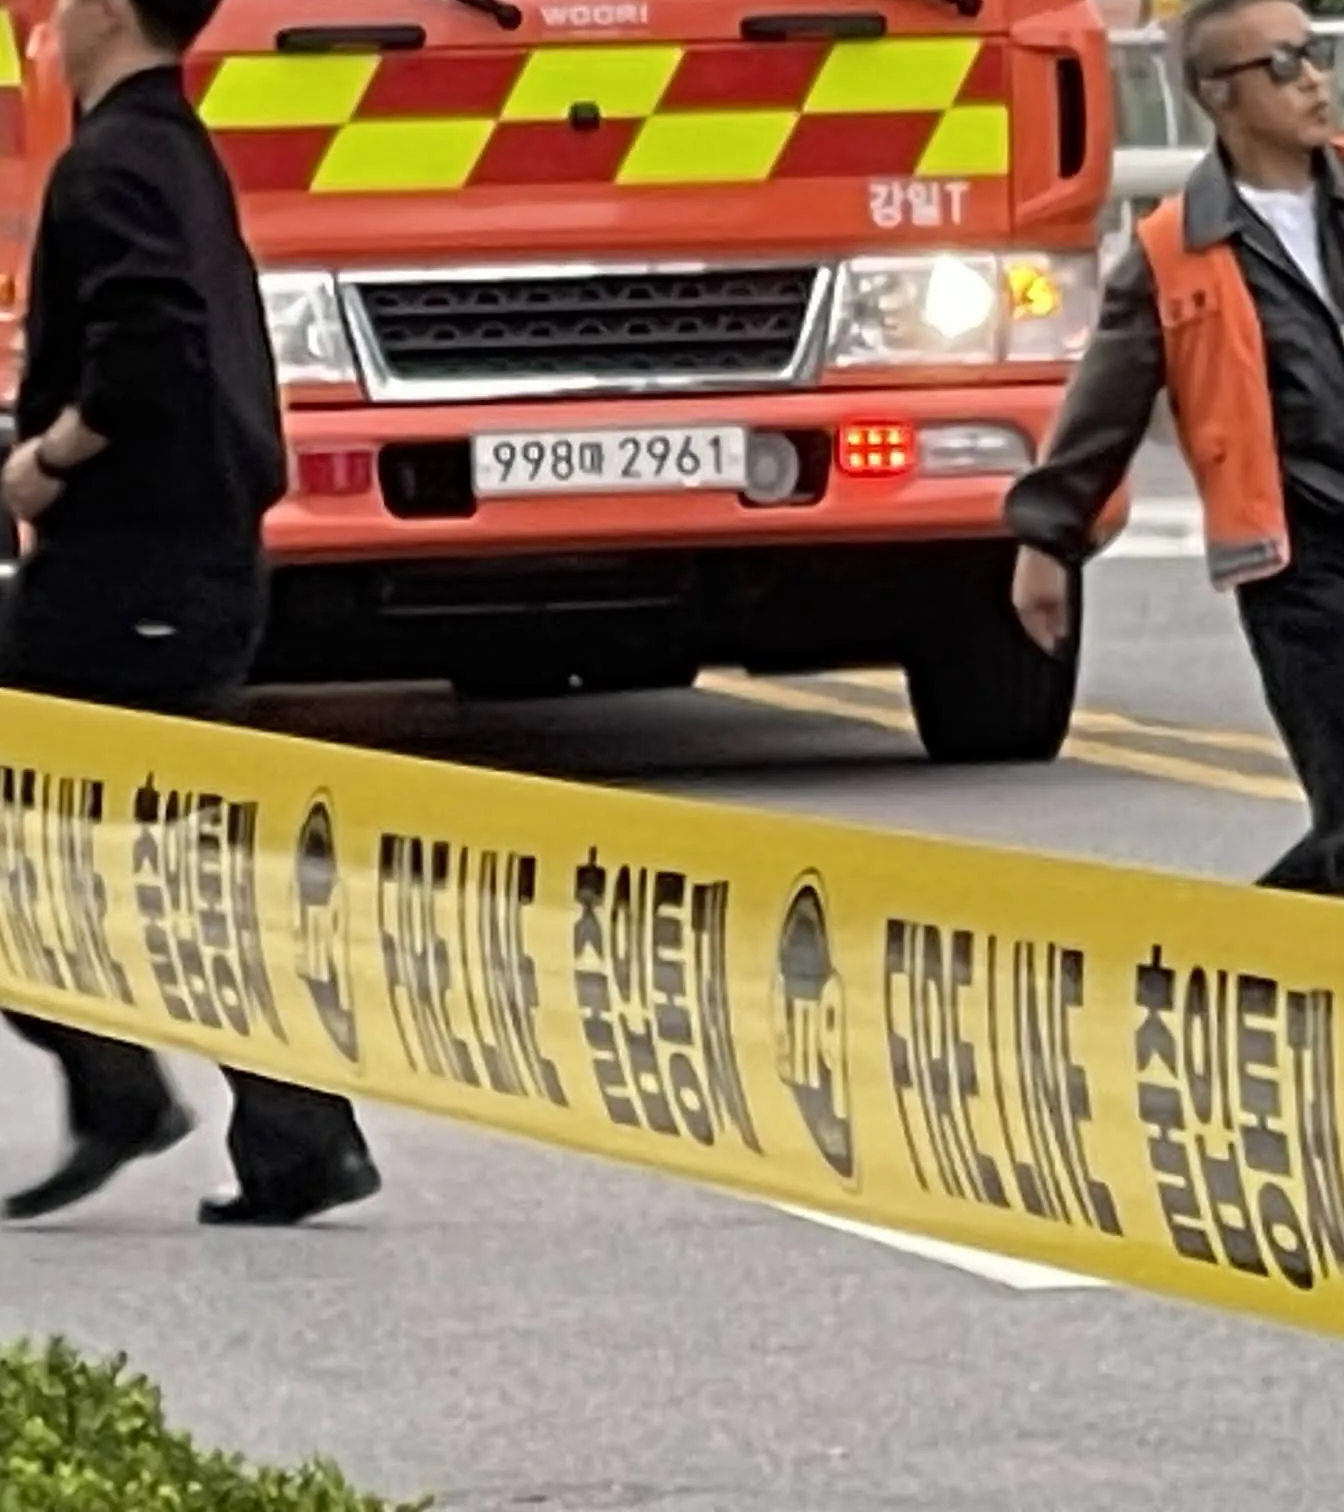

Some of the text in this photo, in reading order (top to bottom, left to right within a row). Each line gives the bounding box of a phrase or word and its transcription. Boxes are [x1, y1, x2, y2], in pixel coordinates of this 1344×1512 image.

[618, 434, 723, 479] 2961
[574, 845, 766, 1157] 출입통제
[885, 917, 1011, 1210] FIRE
[987, 934, 1124, 1237] LINE
